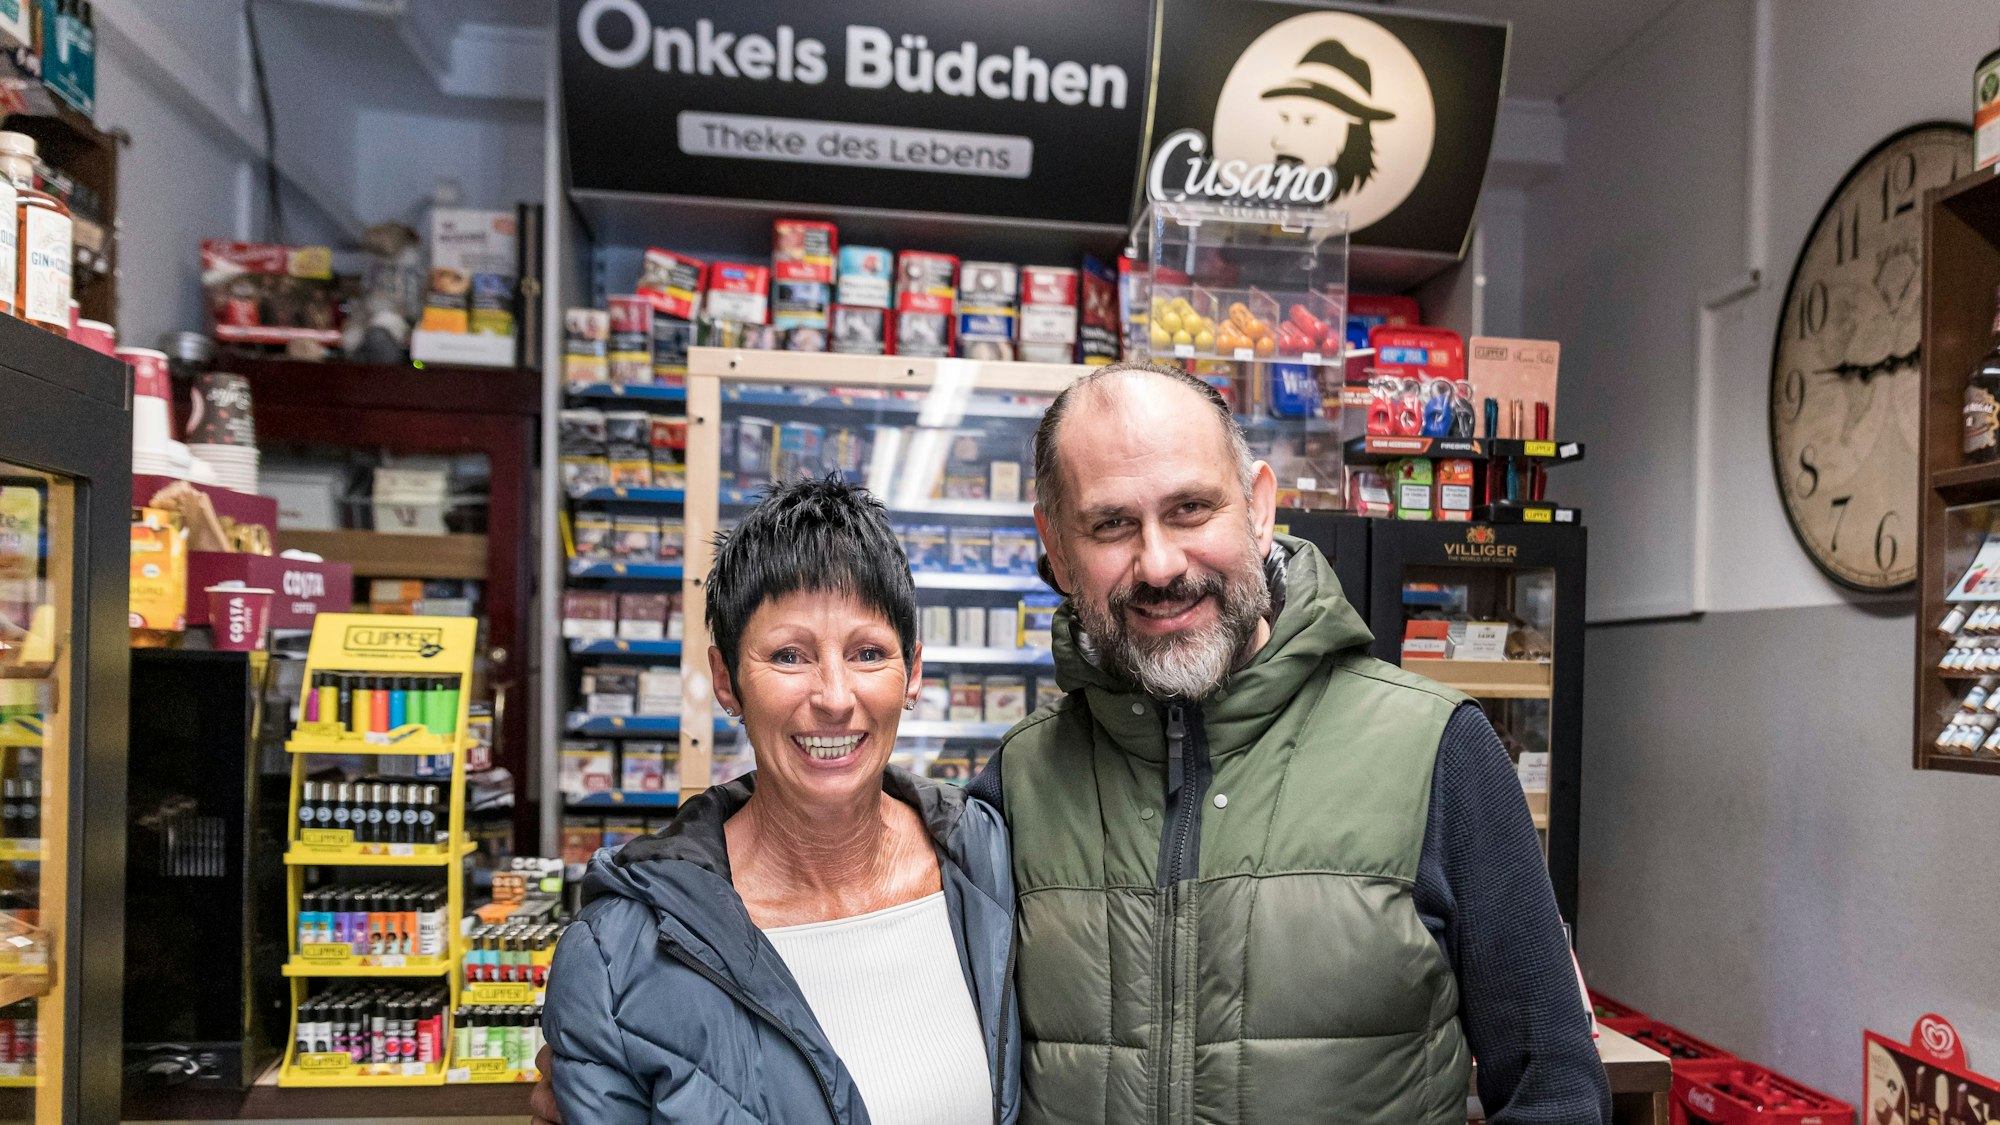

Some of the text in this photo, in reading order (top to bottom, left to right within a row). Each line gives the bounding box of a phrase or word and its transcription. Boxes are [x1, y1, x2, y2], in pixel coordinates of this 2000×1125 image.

[577, 0, 1128, 110] Onkels Büdchen
[702, 122, 1011, 171] Theke des Lebens
[1150, 132, 1335, 203] Cusano
[1881, 153, 1917, 223] 12
[32, 251, 49, 268] GIN
[1836, 203, 1860, 266] 11
[1800, 280, 1829, 341] 10
[1786, 368, 1805, 421] 9
[1441, 442, 1471, 450] FIREBIRD
[1796, 446, 1819, 499] 8
[1444, 543, 1518, 557] VILLIGER
[1831, 494, 1852, 553] 7
[1874, 510, 1900, 570] 6
[283, 570, 325, 599] COSTA
[229, 597, 245, 643] COSTA
[353, 630, 437, 649] CLIPPER
